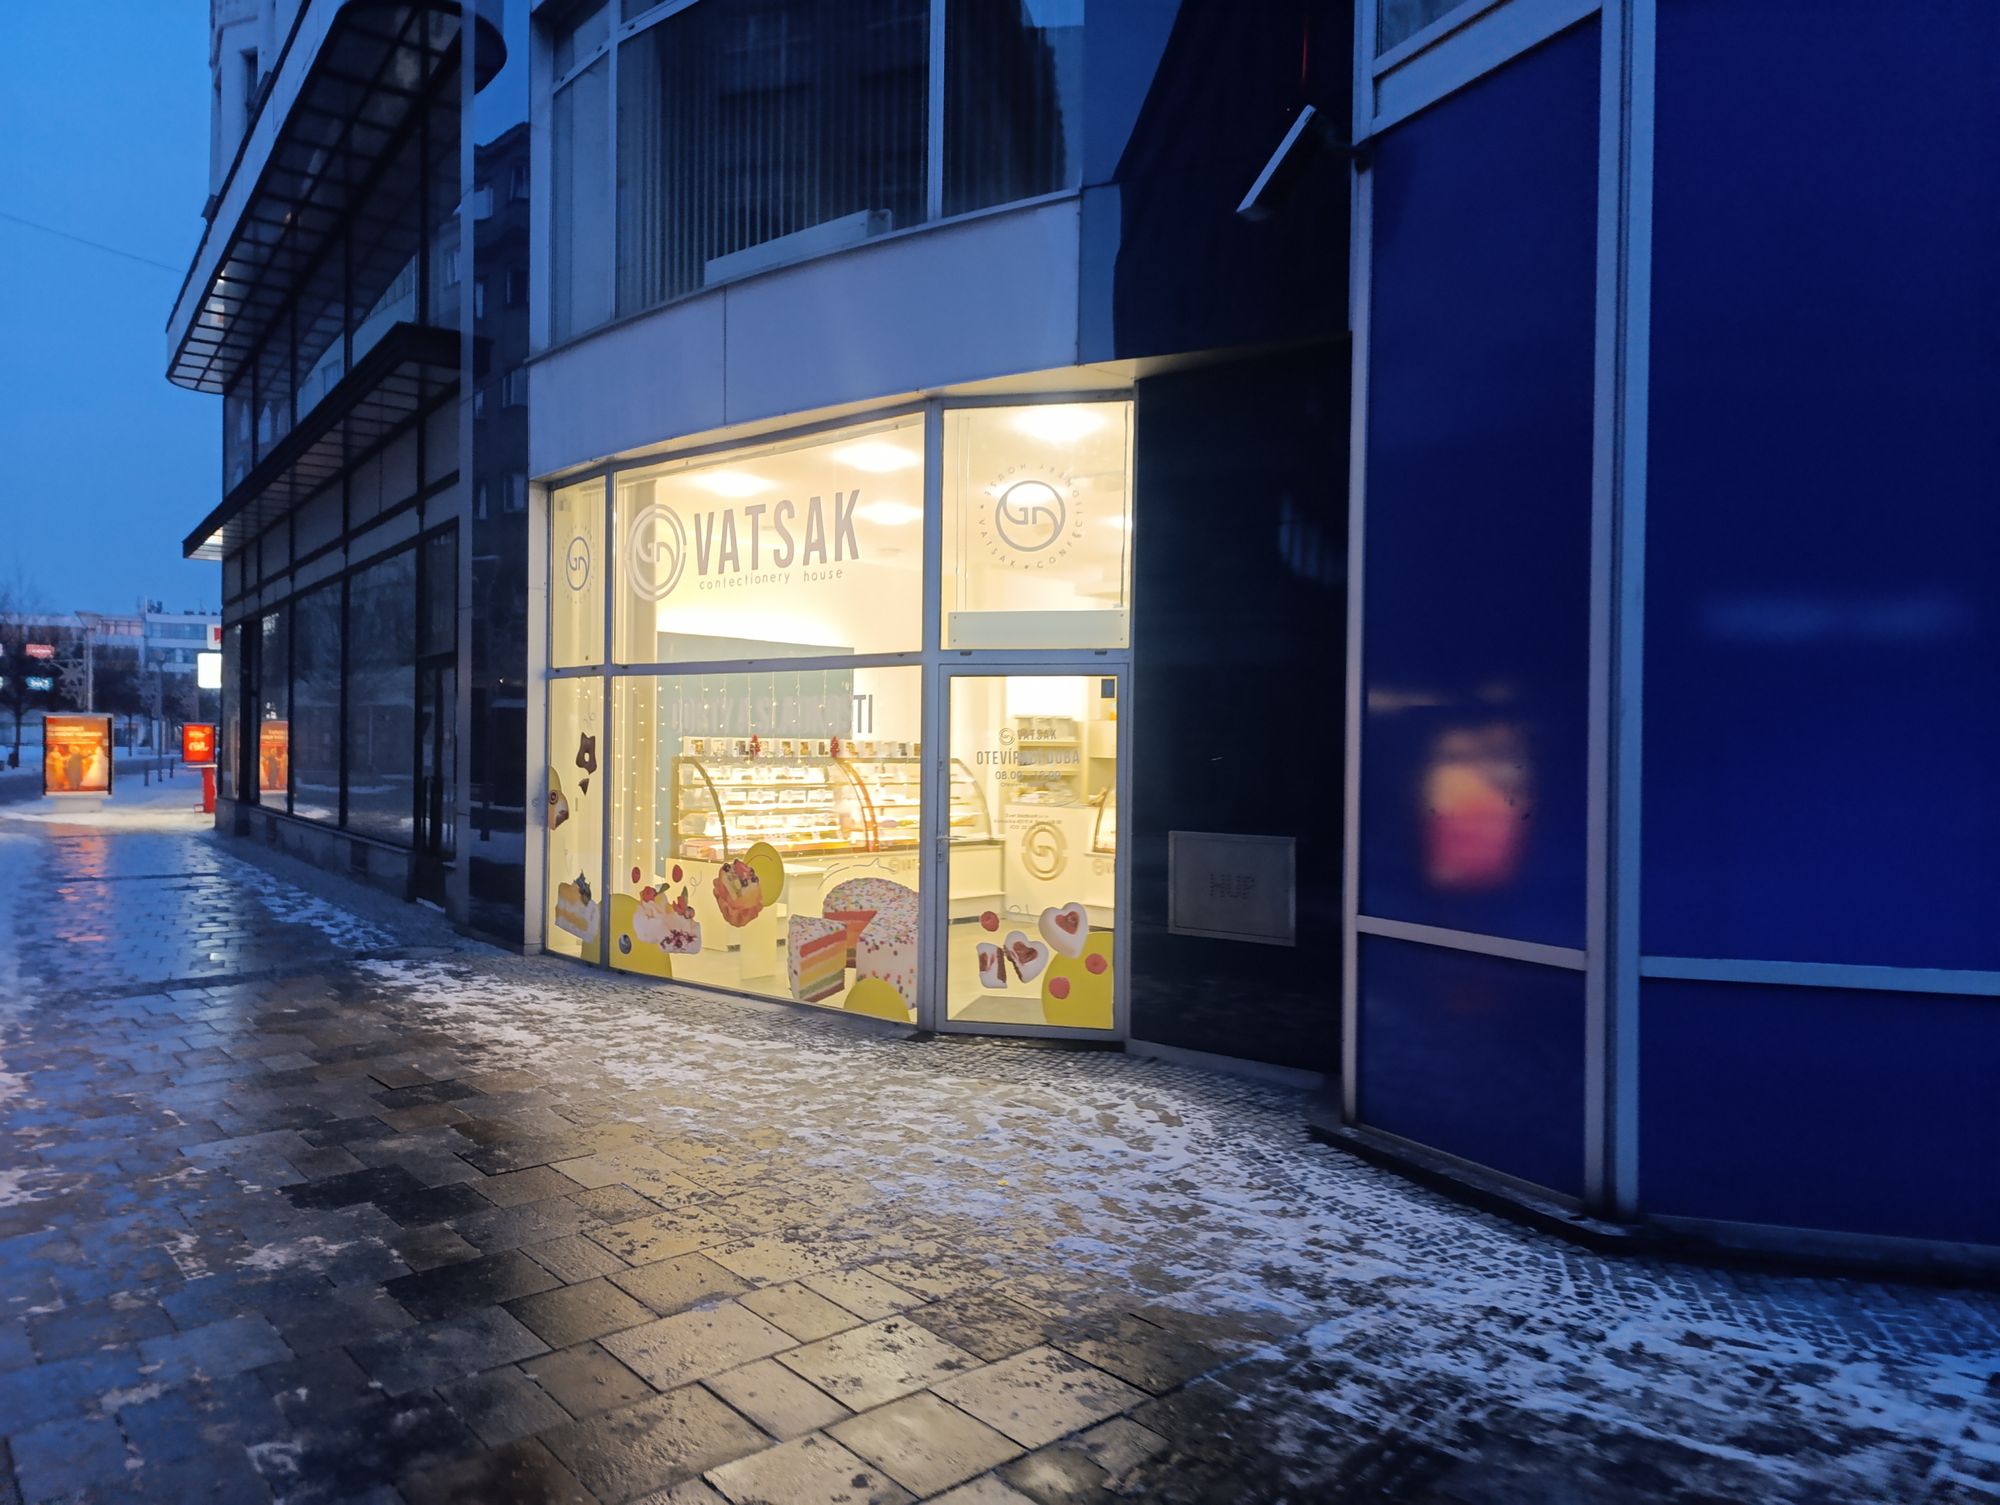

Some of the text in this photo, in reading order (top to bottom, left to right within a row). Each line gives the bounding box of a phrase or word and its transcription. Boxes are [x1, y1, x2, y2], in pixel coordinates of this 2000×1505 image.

[694, 489, 860, 576] VATSAK
[699, 568, 843, 590] confectionery house
[1017, 728, 1057, 740] VATSAK
